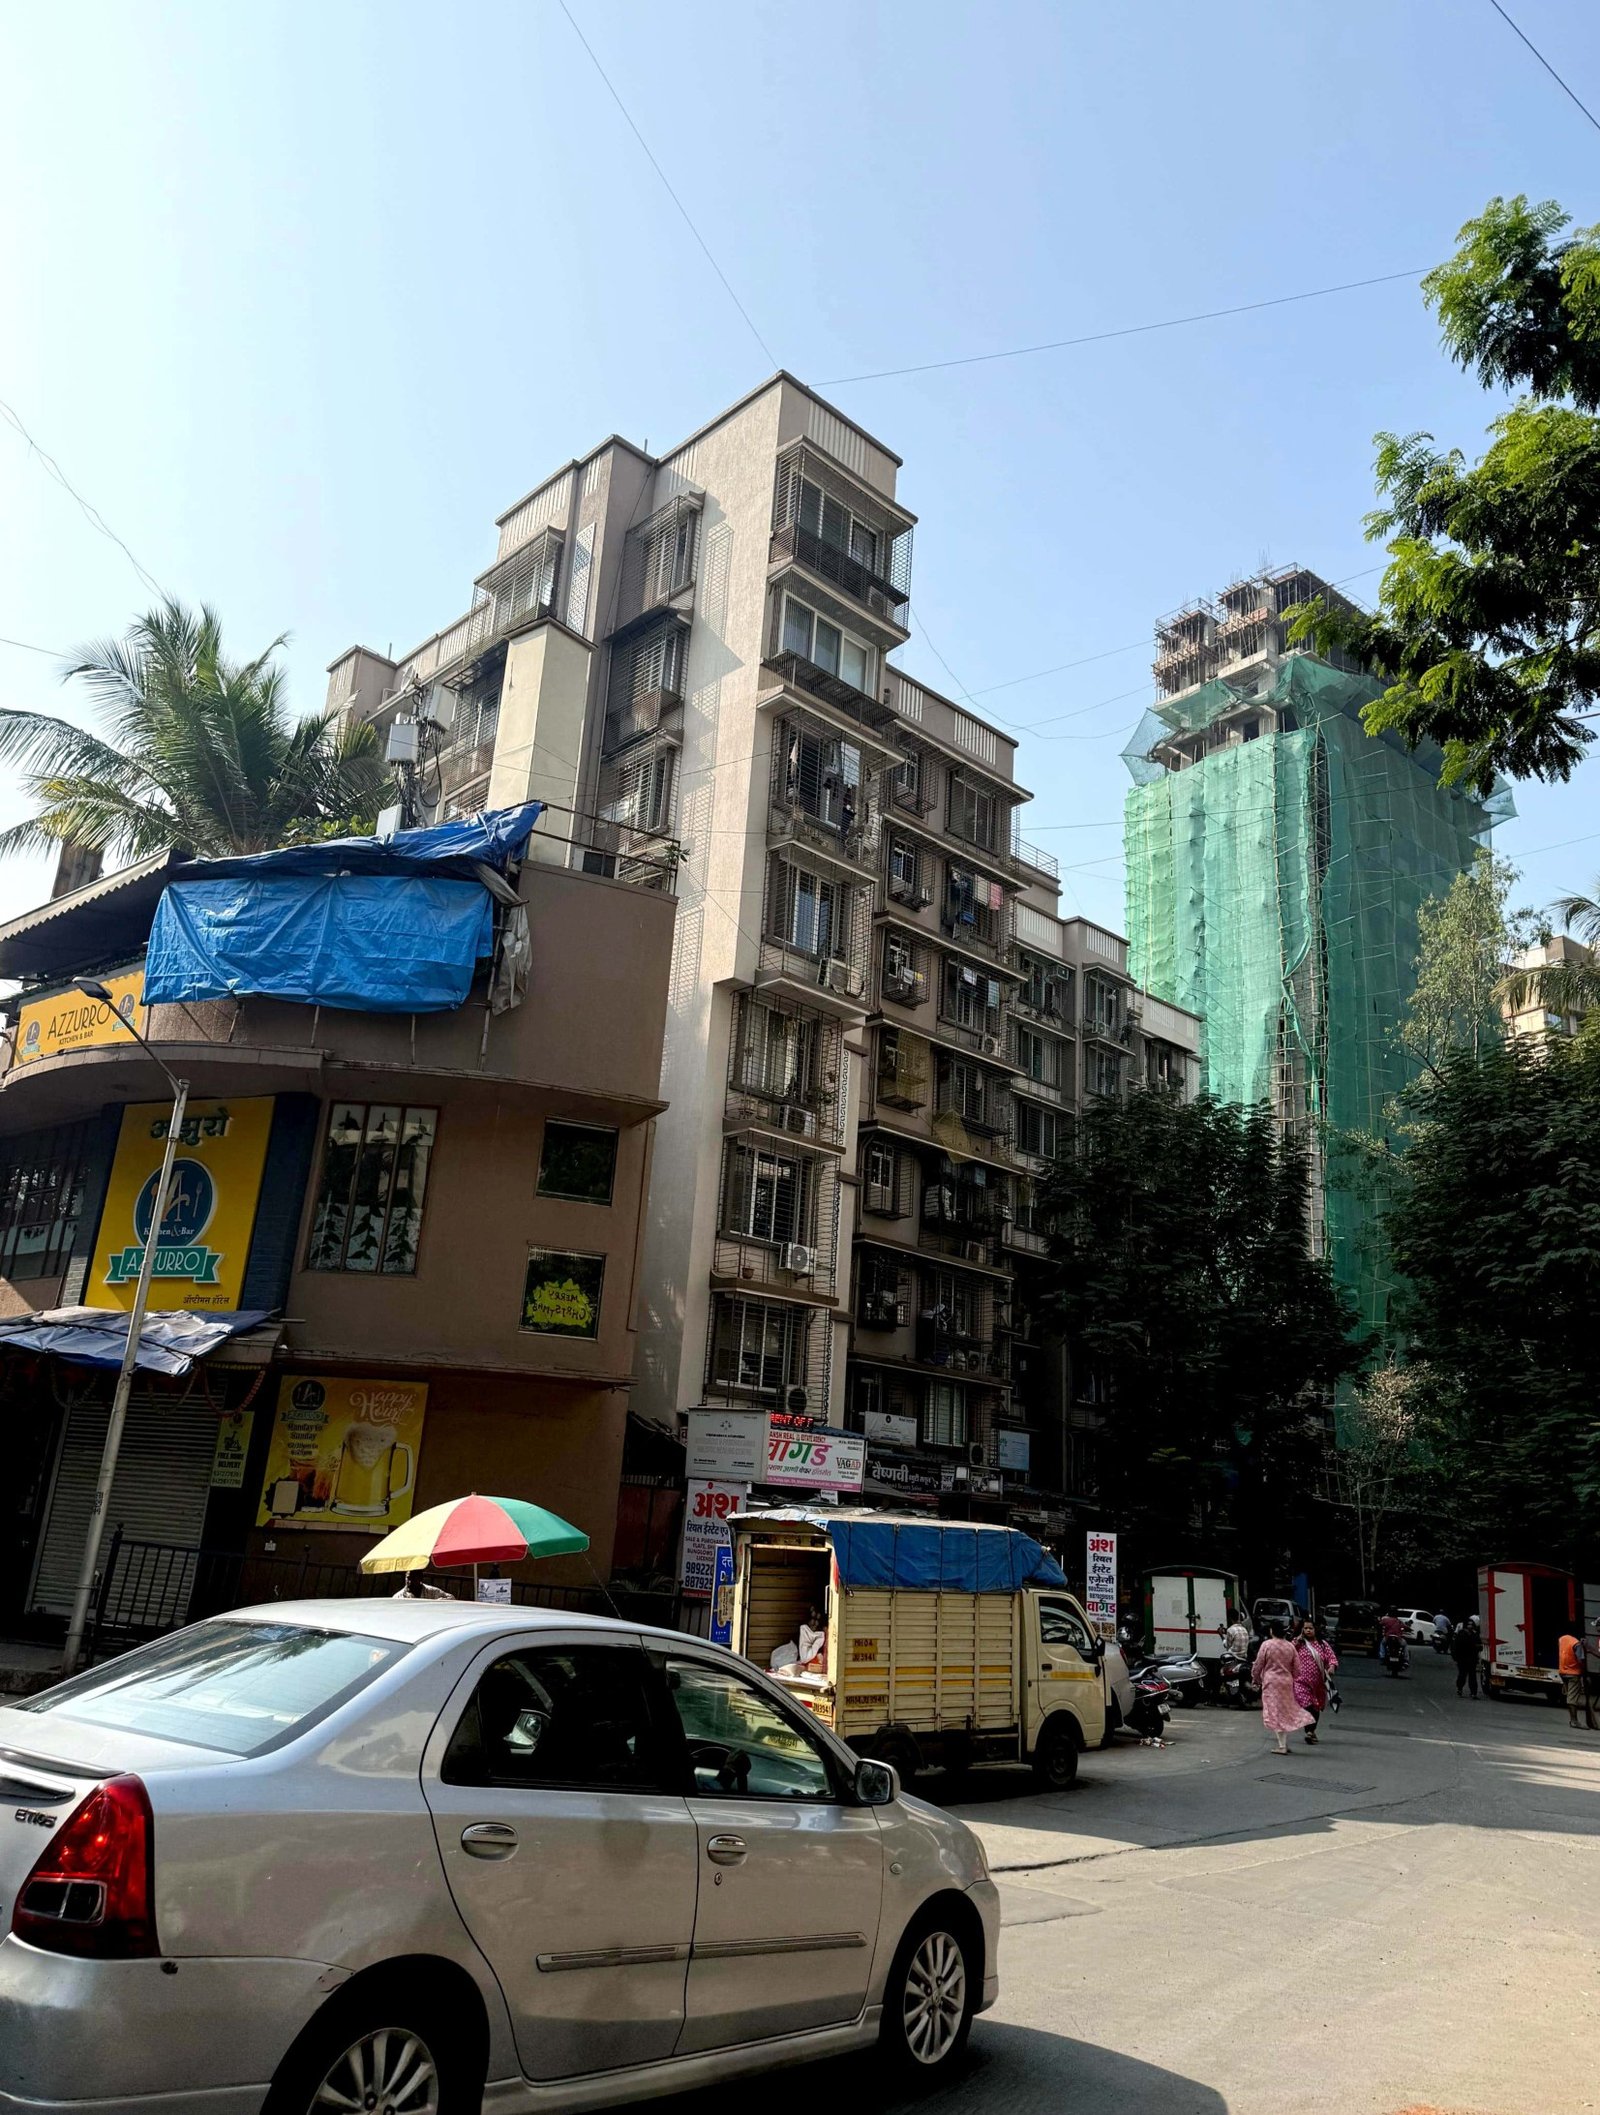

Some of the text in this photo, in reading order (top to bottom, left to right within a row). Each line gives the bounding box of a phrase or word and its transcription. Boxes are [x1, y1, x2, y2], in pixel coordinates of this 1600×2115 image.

[48, 1003, 110, 1040] AZZURRO
[59, 1034, 79, 1045] KITCHEN
[84, 1030, 94, 1038] BAR
[181, 1227, 195, 1235] Bar
[126, 1251, 200, 1272] AURRO
[836, 1457, 861, 1469] VAGAD
[872, 1461, 909, 1483] वैष्णवी
[693, 1482, 740, 1520] अंश
[1088, 1534, 1114, 1553] अंश
[1087, 1601, 1115, 1614] वागड
[812, 1701, 832, 1714] JU3941
[15, 1809, 57, 1828] ETIOS
